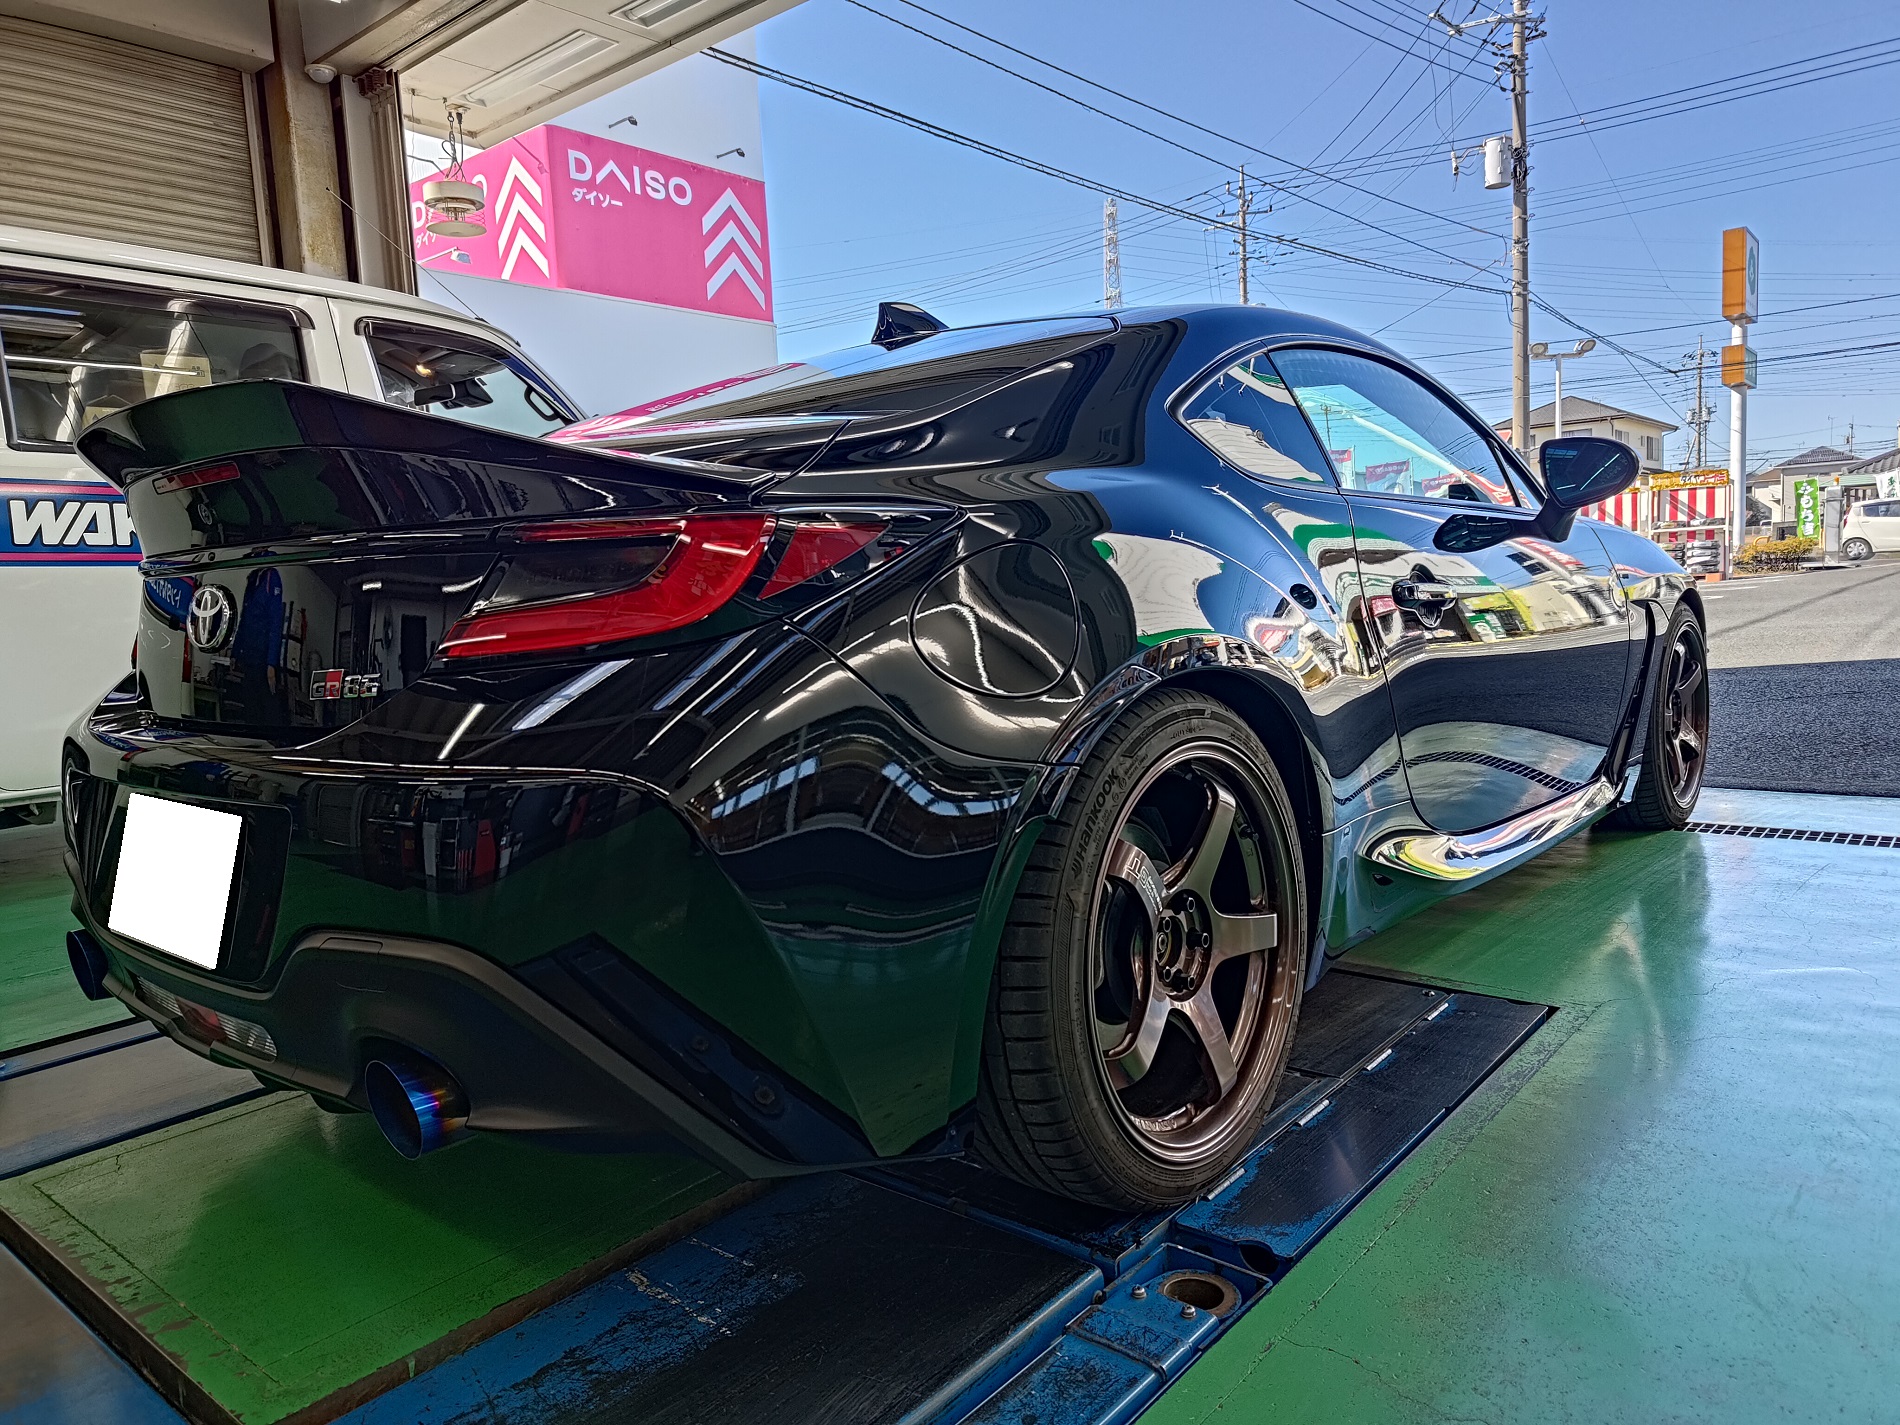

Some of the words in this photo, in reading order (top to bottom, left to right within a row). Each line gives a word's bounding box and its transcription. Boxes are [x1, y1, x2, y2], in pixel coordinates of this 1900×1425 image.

[567, 148, 693, 206] DAISO
[572, 187, 623, 208] ダイソー
